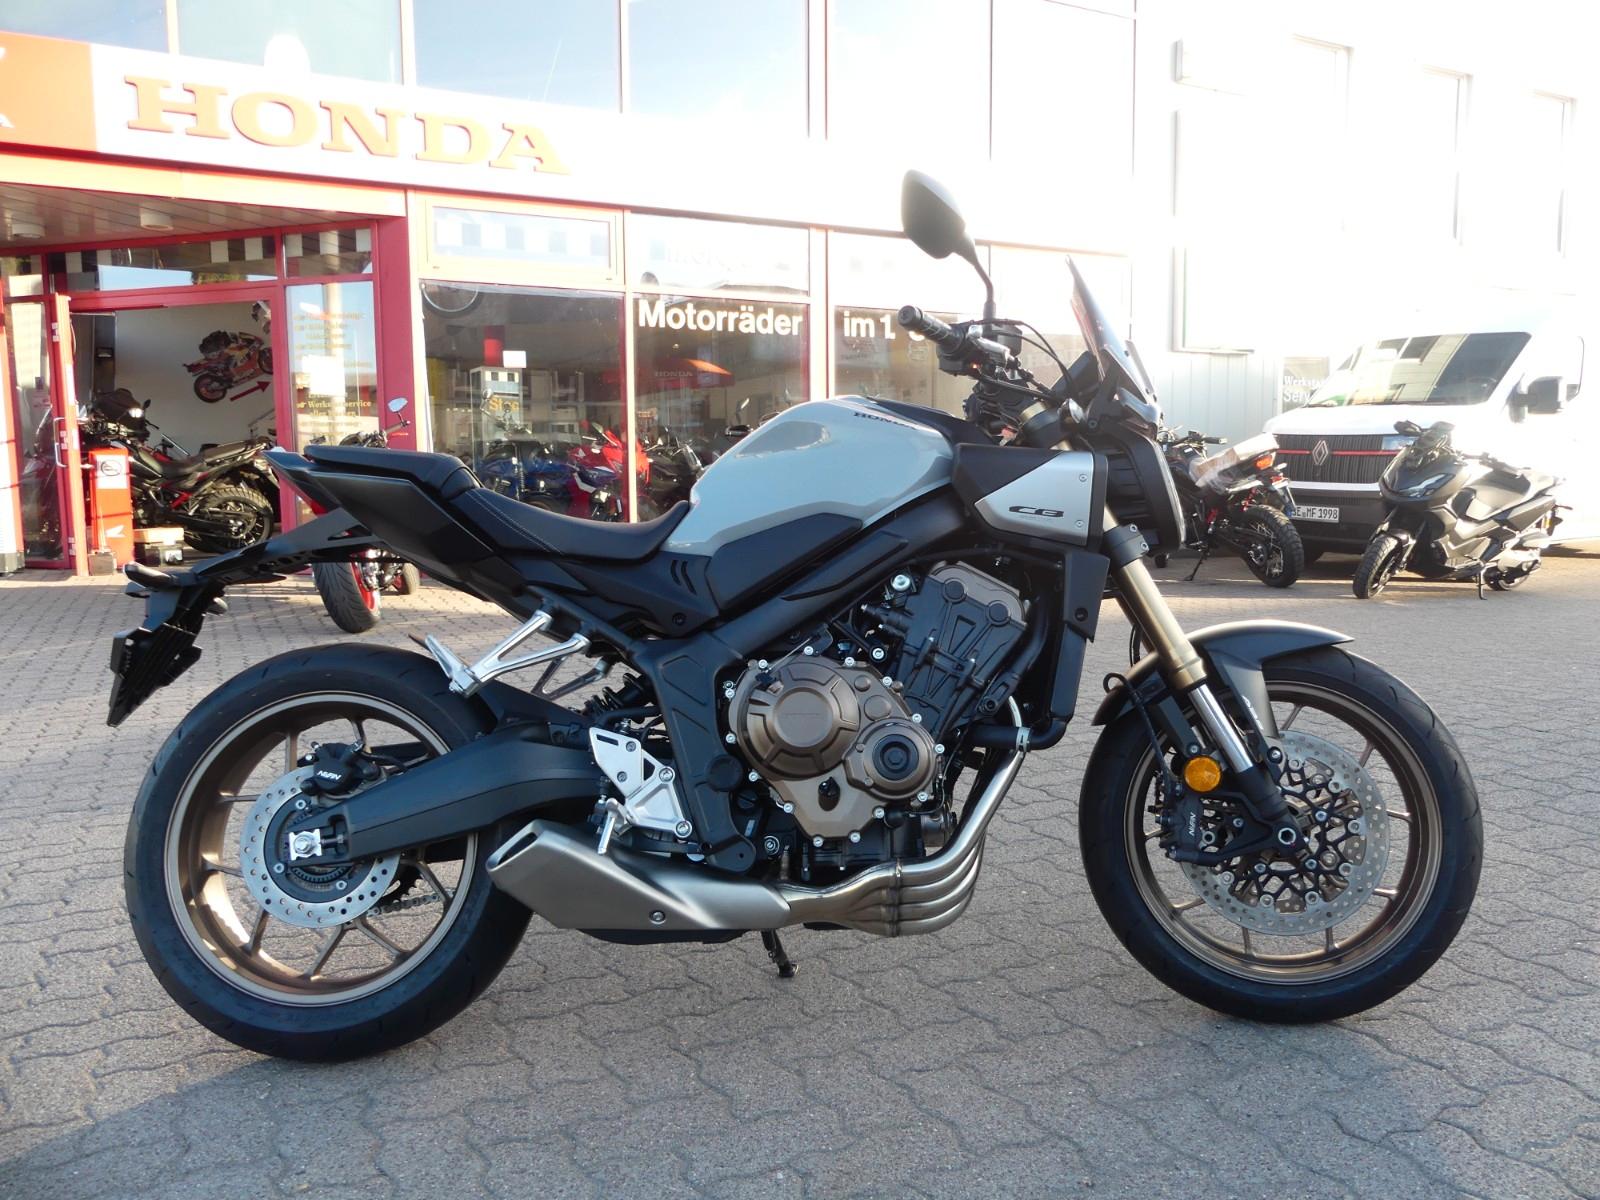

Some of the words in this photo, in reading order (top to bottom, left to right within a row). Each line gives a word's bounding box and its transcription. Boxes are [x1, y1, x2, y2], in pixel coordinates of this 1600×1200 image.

[124, 75, 571, 174] HONDA
[638, 299, 803, 336] Motorräder
[843, 310, 875, 338] im
[880, 314, 896, 340] 1.
[1009, 506, 1065, 518] CB
[1318, 508, 1338, 519] 1998
